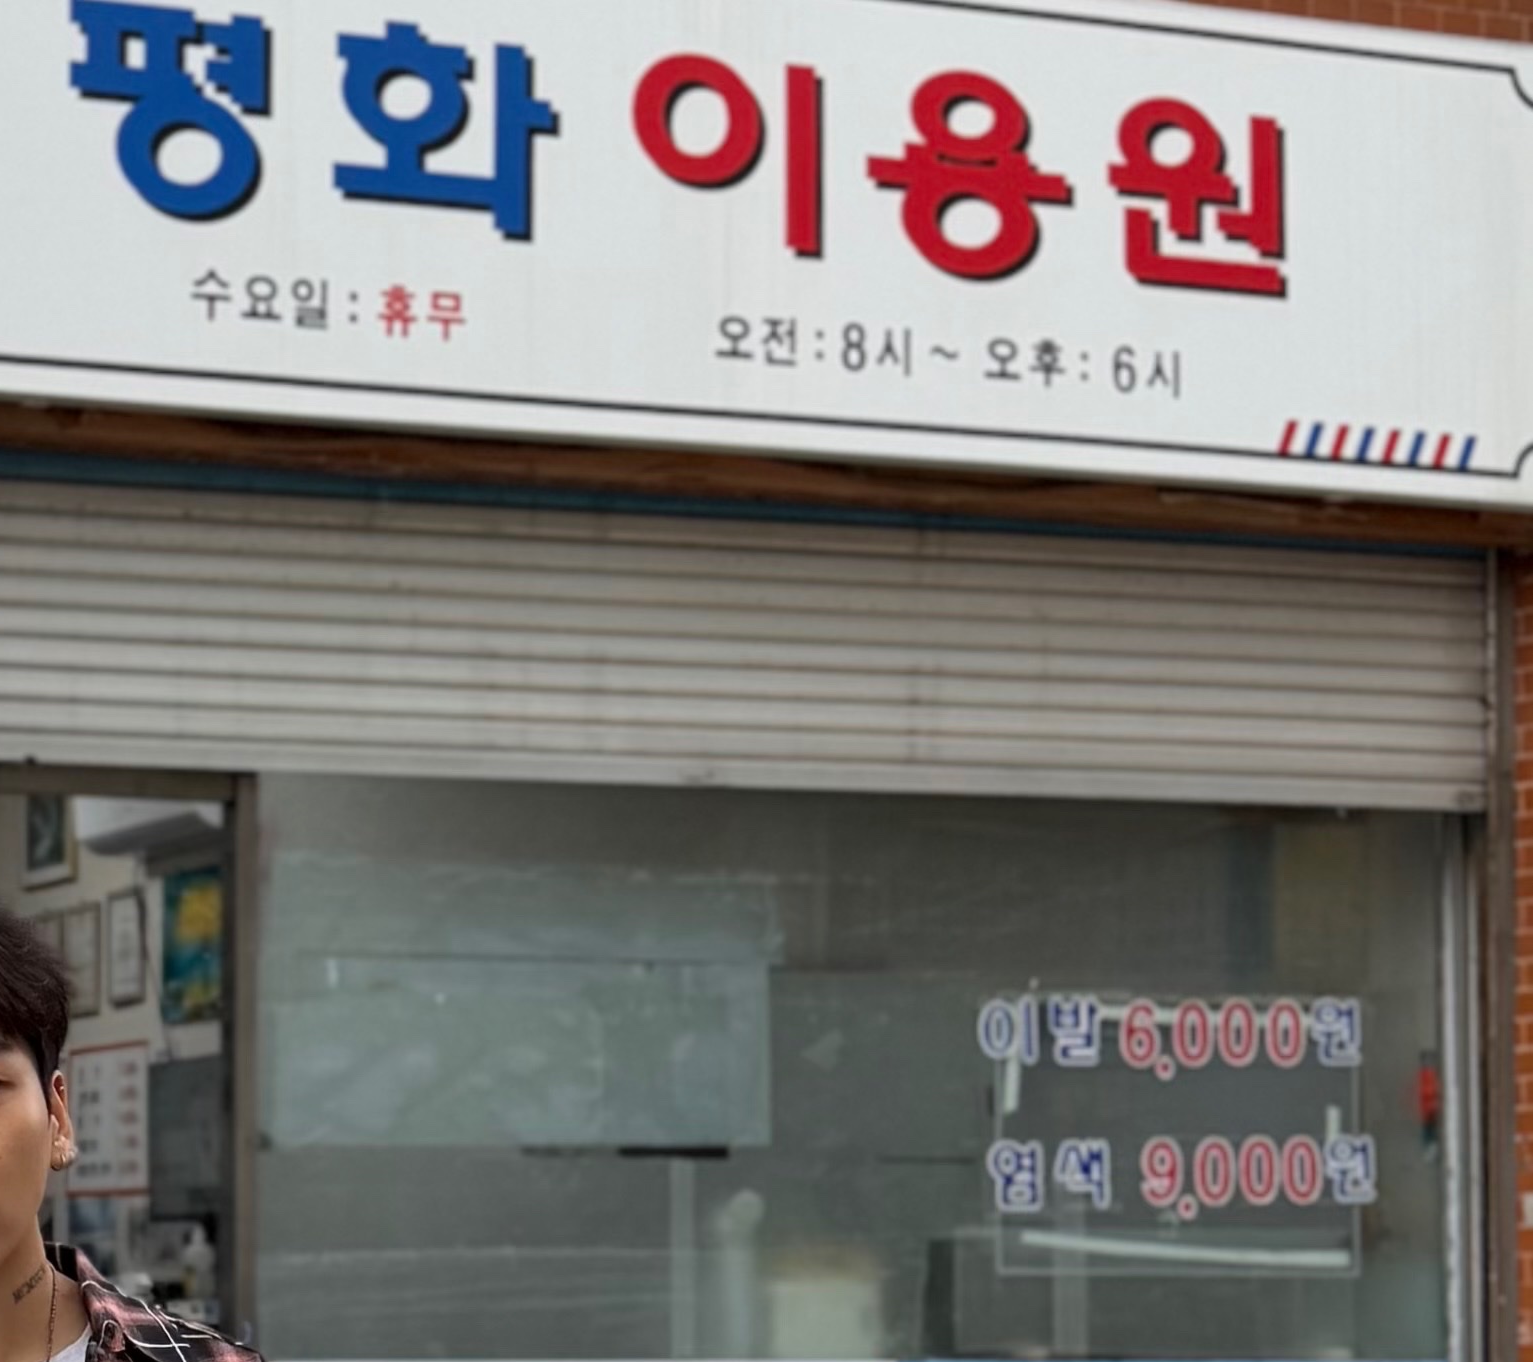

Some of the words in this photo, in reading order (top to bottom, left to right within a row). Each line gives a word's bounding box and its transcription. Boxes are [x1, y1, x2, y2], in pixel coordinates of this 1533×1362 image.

[69, 0, 559, 242] 평화
[632, 53, 1287, 298] 이용원
[979, 994, 1101, 1065] 이발
[987, 1138, 1110, 1210] 염색
